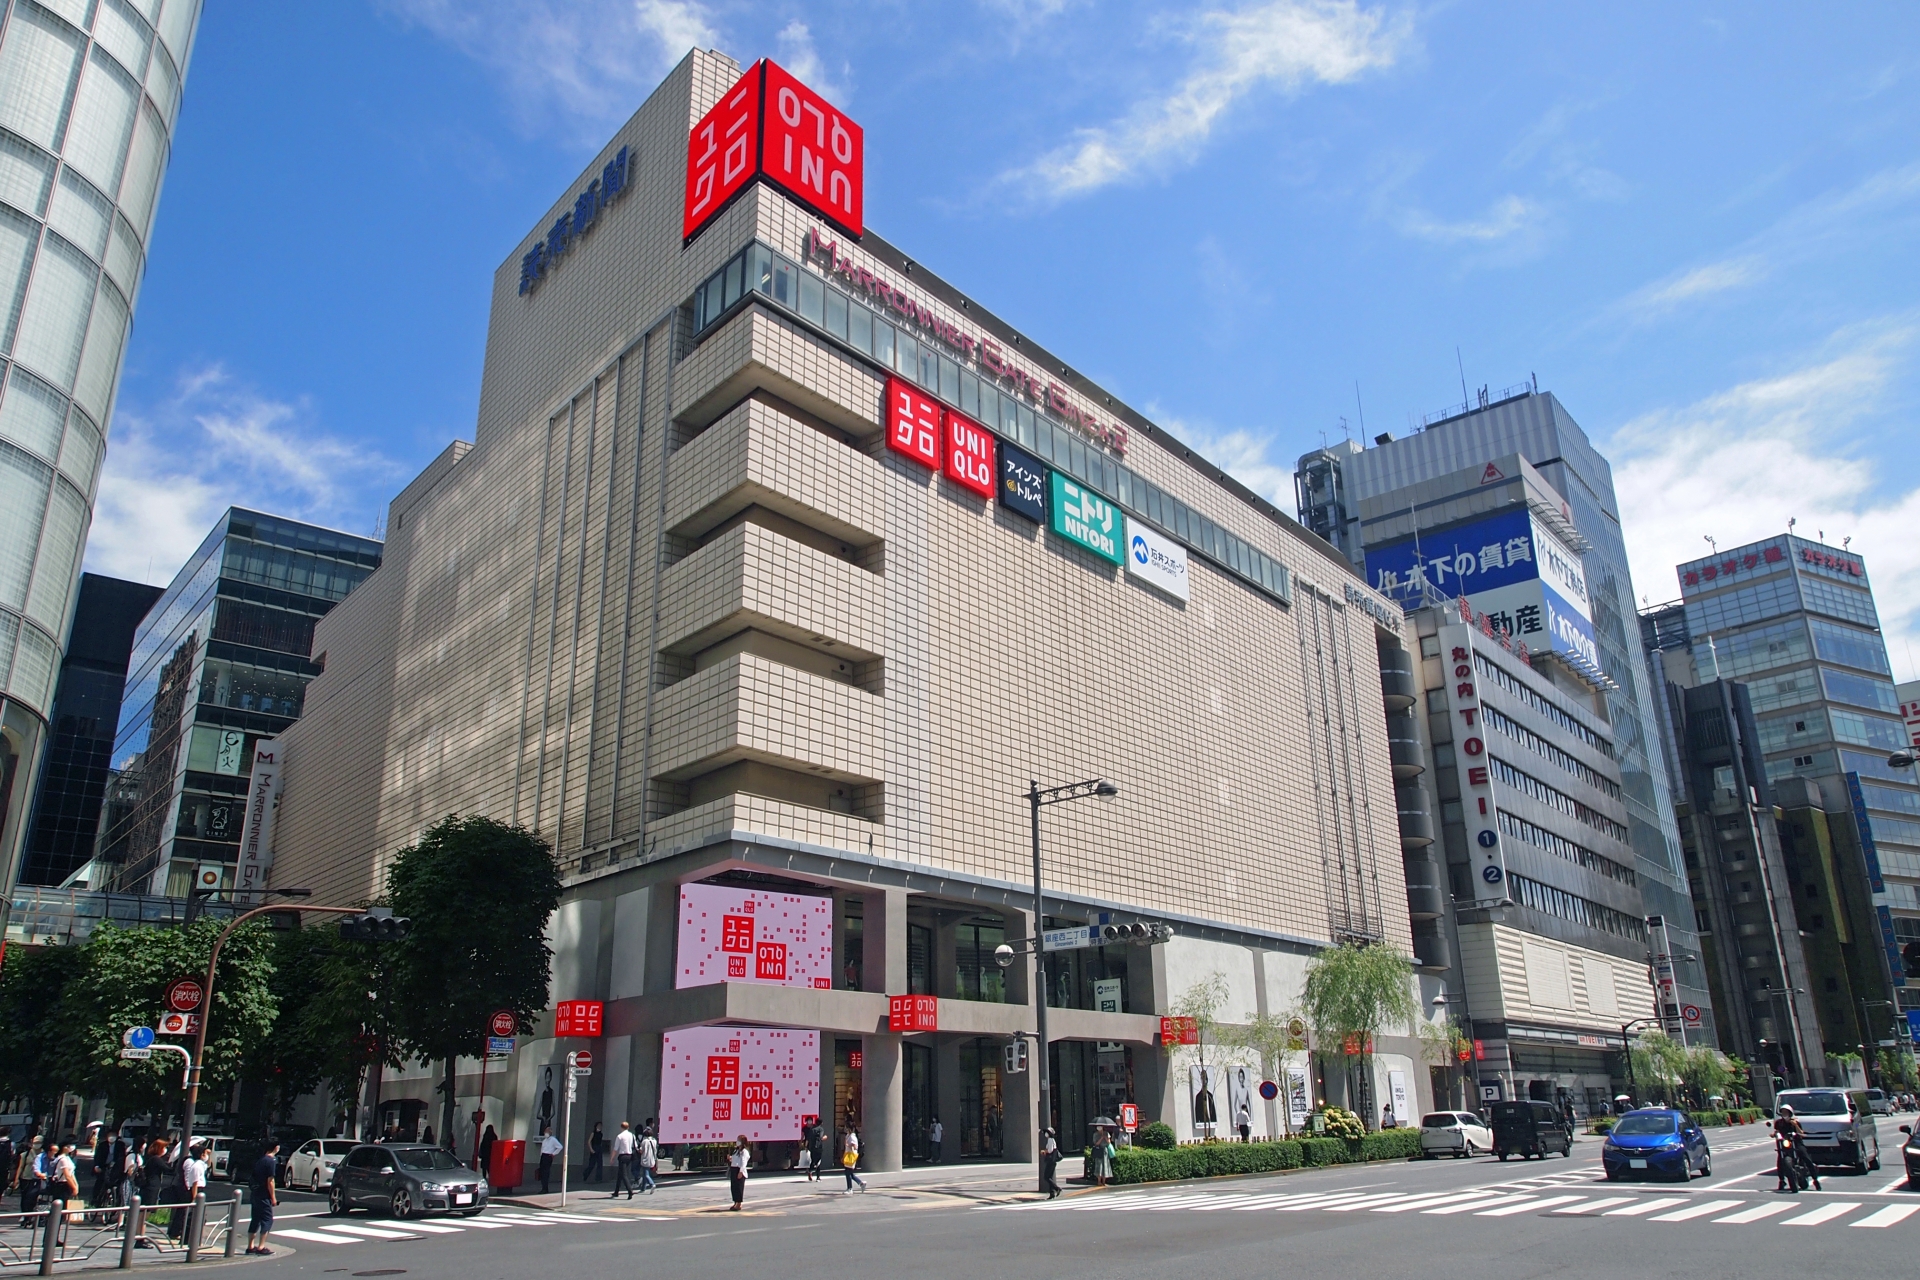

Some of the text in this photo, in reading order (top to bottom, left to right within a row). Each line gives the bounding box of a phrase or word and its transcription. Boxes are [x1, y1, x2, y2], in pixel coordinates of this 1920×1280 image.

[697, 87, 748, 168] ユニ
[778, 86, 853, 164] QLO
[692, 131, 747, 217] クロ
[784, 133, 852, 214] UNI
[982, 337, 1042, 399] GATE
[898, 392, 934, 430] ユニ
[897, 419, 934, 458] クロ
[953, 422, 986, 460] UNI
[954, 450, 990, 486] QLO
[1006, 460, 1042, 490] アインズ
[1017, 482, 1043, 507] トルペ
[1064, 482, 1113, 534] ニトリ
[1065, 515, 1114, 556] NITORI
[1150, 547, 1185, 574] 石井スポーツ
[1405, 536, 1532, 592] 木下の賃貸
[1683, 546, 1784, 586] カラオケ館
[1803, 548, 1862, 577] カラオケ館
[1161, 564, 1177, 578] SPORTS
[246, 773, 272, 860] MARRONNIER
[726, 919, 750, 933] ユニ
[725, 935, 750, 949] クロ
[1045, 930, 1087, 942] 銀座西二丁目
[759, 946, 783, 960] QLO
[730, 958, 744, 966] UNI
[761, 961, 783, 975] UNI
[729, 967, 744, 976] QLO
[815, 980, 828, 988] UNI
[174, 990, 200, 1002] 消火栓
[917, 998, 935, 1012] QLO
[495, 1020, 512, 1029] 消火栓
[918, 1013, 935, 1026] UNI
[711, 1061, 735, 1074] ユニ
[709, 1077, 735, 1090] クロ
[745, 1084, 770, 1099] QLO
[1485, 1088, 1494, 1099] P
[715, 1101, 728, 1109] UNI
[746, 1102, 769, 1116] UNI
[714, 1110, 729, 1119] QLO
[802, 1117, 815, 1125] UI
